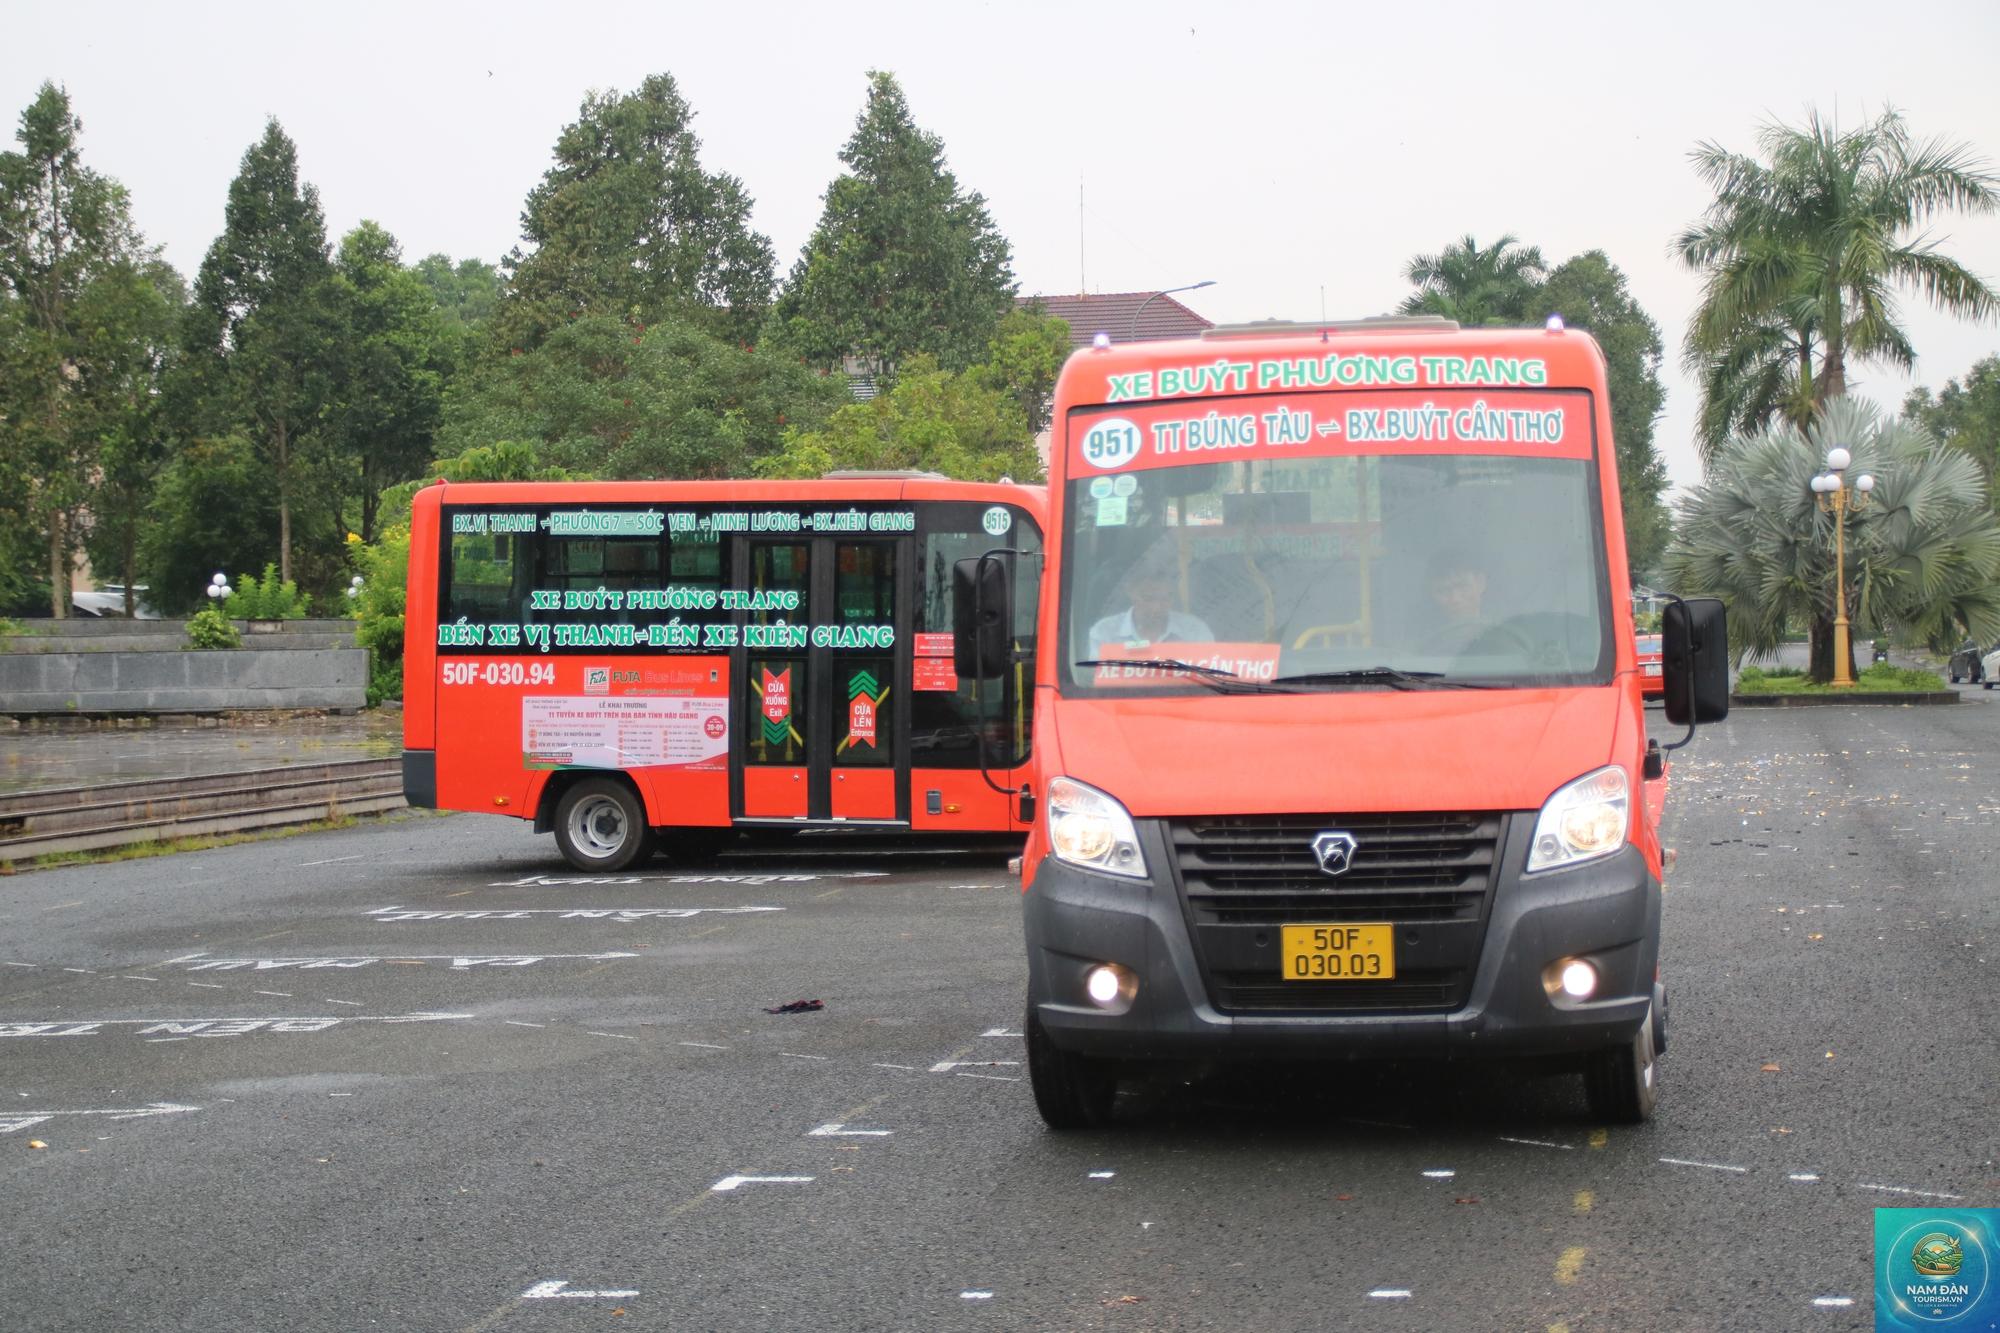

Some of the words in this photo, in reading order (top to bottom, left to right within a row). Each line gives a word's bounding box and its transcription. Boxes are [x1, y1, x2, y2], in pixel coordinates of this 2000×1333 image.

[1107, 373, 1151, 402] XE
[1159, 362, 1252, 396] BUÝT
[1258, 355, 1416, 389] PHƯƠNG
[1421, 356, 1547, 385] TRANG
[1152, 421, 1184, 454] TT
[1186, 411, 1256, 450] BÚNG
[1263, 407, 1312, 444] TÀU
[1346, 403, 1450, 442] BX.BUÝT
[1453, 400, 1507, 441] CẦN
[1509, 408, 1564, 444] THƠ
[1088, 426, 1135, 459] 951
[452, 513, 488, 535] BX.VỊ
[489, 514, 537, 533] THANH
[553, 508, 611, 532] PHƯỜNG
[612, 514, 621, 531] 7
[636, 508, 664, 532] SÓC
[668, 513, 696, 532] VEN
[712, 513, 749, 532] MINH
[751, 510, 800, 532] LƯƠNG
[812, 508, 867, 532] BX.KIÊN
[868, 513, 915, 532] GIANG
[986, 512, 1009, 530] 9515
[531, 590, 561, 609] XE
[564, 586, 624, 610] BUÝT
[626, 586, 718, 610] PHƯƠNG
[720, 589, 800, 610] TRANG
[438, 616, 484, 646] BẾN
[488, 624, 520, 646] XE
[523, 624, 550, 653] VỊ
[554, 624, 635, 647] THANH
[648, 616, 699, 647] BẾN
[703, 624, 738, 647] XE
[743, 618, 808, 648] KIÊN
[811, 625, 895, 648] GIANG
[442, 662, 555, 686] 50F-030.94
[613, 670, 640, 683] FUTA
[1236, 658, 1275, 681] THƠ
[769, 708, 783, 717] Exit
[853, 716, 873, 728] LÊN
[1313, 928, 1360, 952] 50F
[1295, 953, 1381, 977] 030.03
